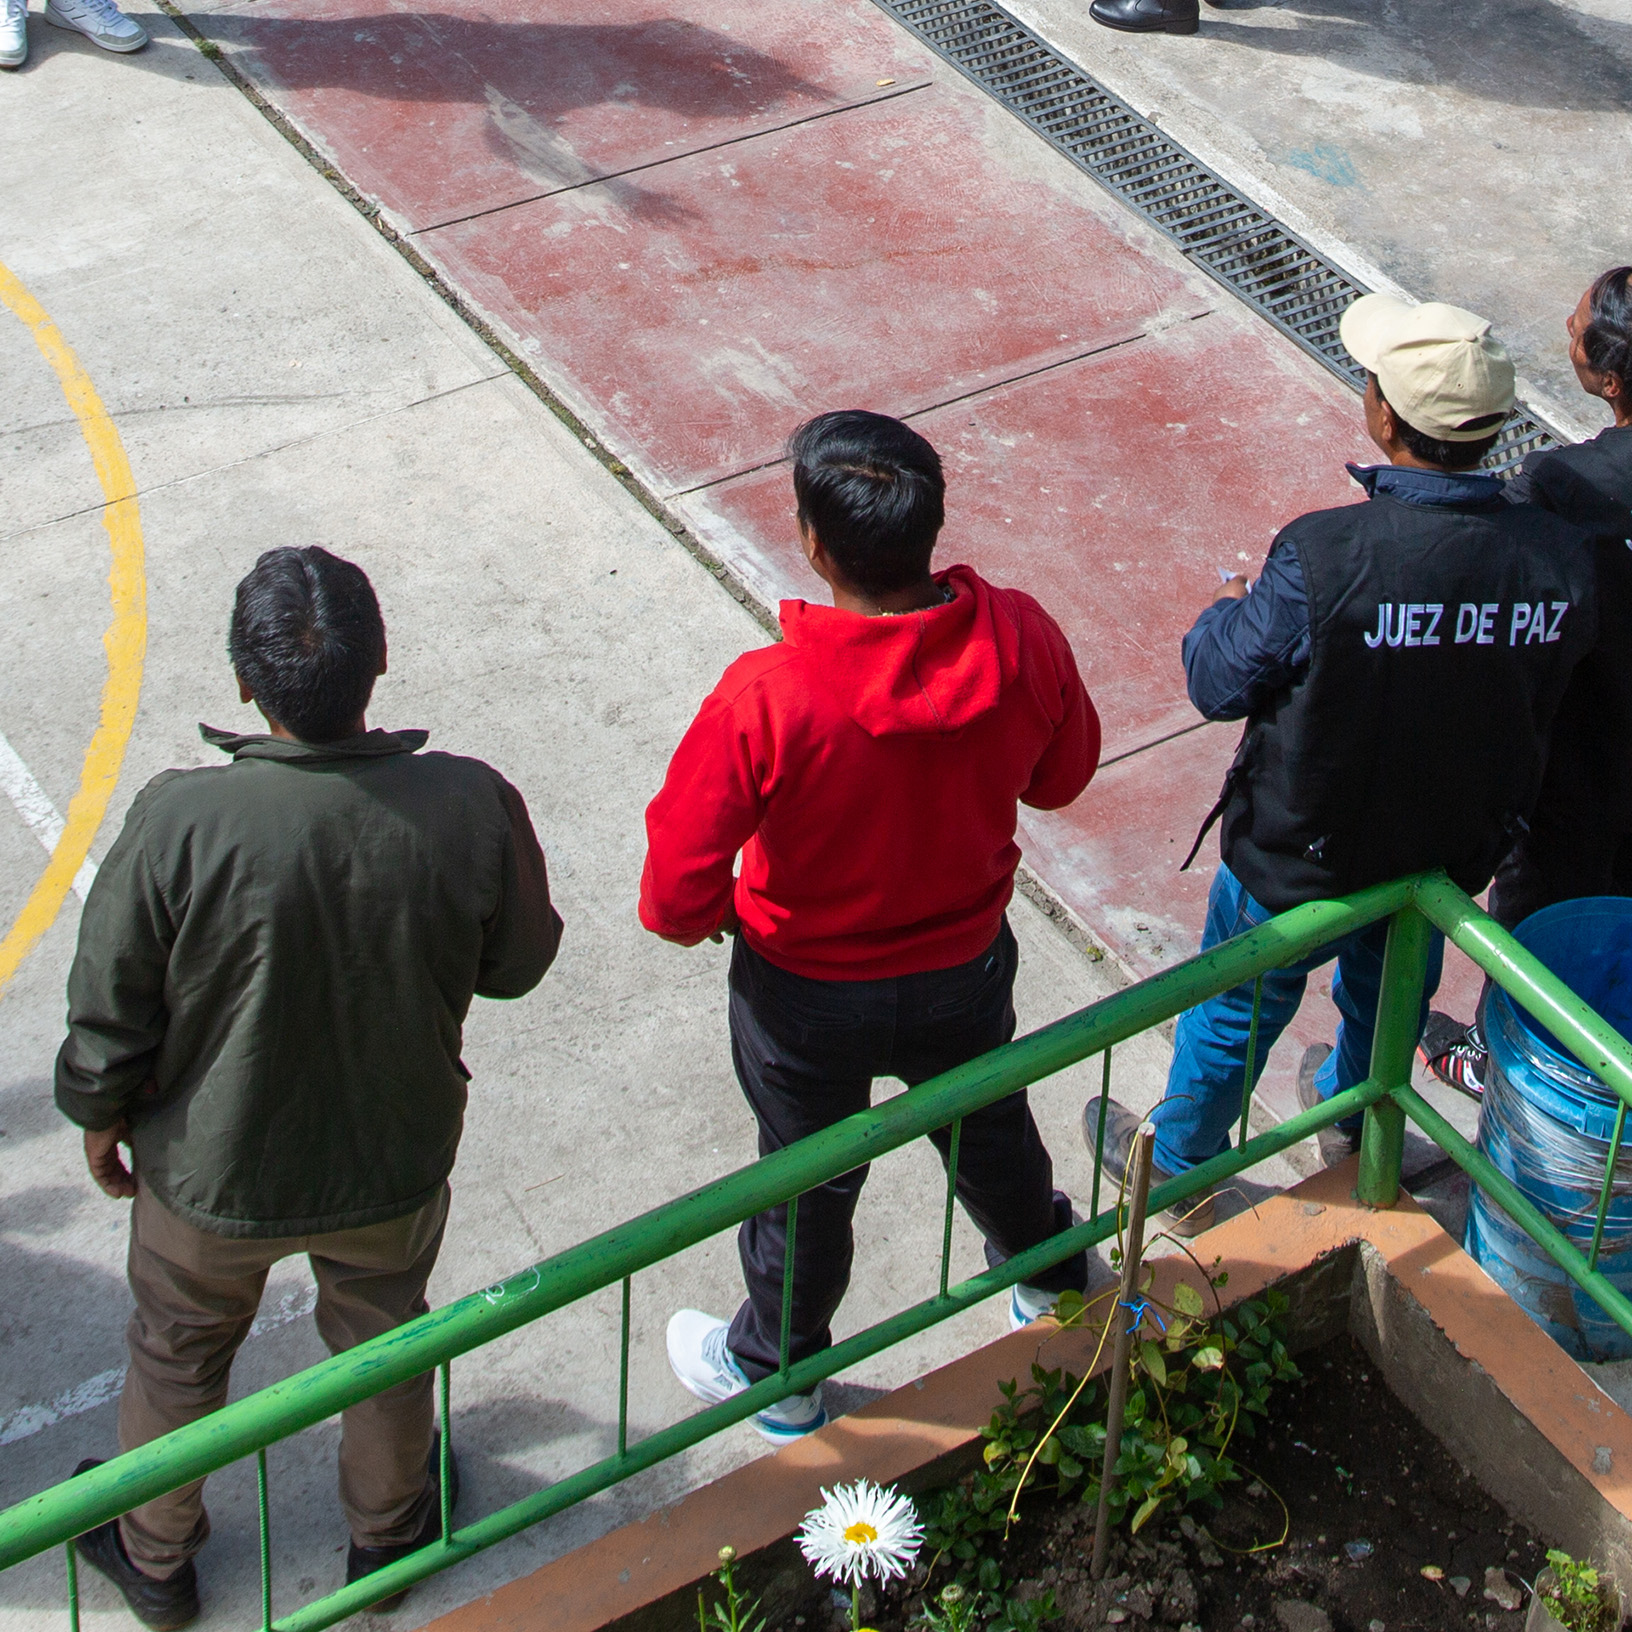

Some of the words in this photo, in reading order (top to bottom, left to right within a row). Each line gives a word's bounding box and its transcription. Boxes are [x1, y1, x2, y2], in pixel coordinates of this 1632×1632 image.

[1364, 603, 1444, 648] JUEZ
[1455, 603, 1500, 646] DE
[1509, 601, 1569, 647] PAZ
